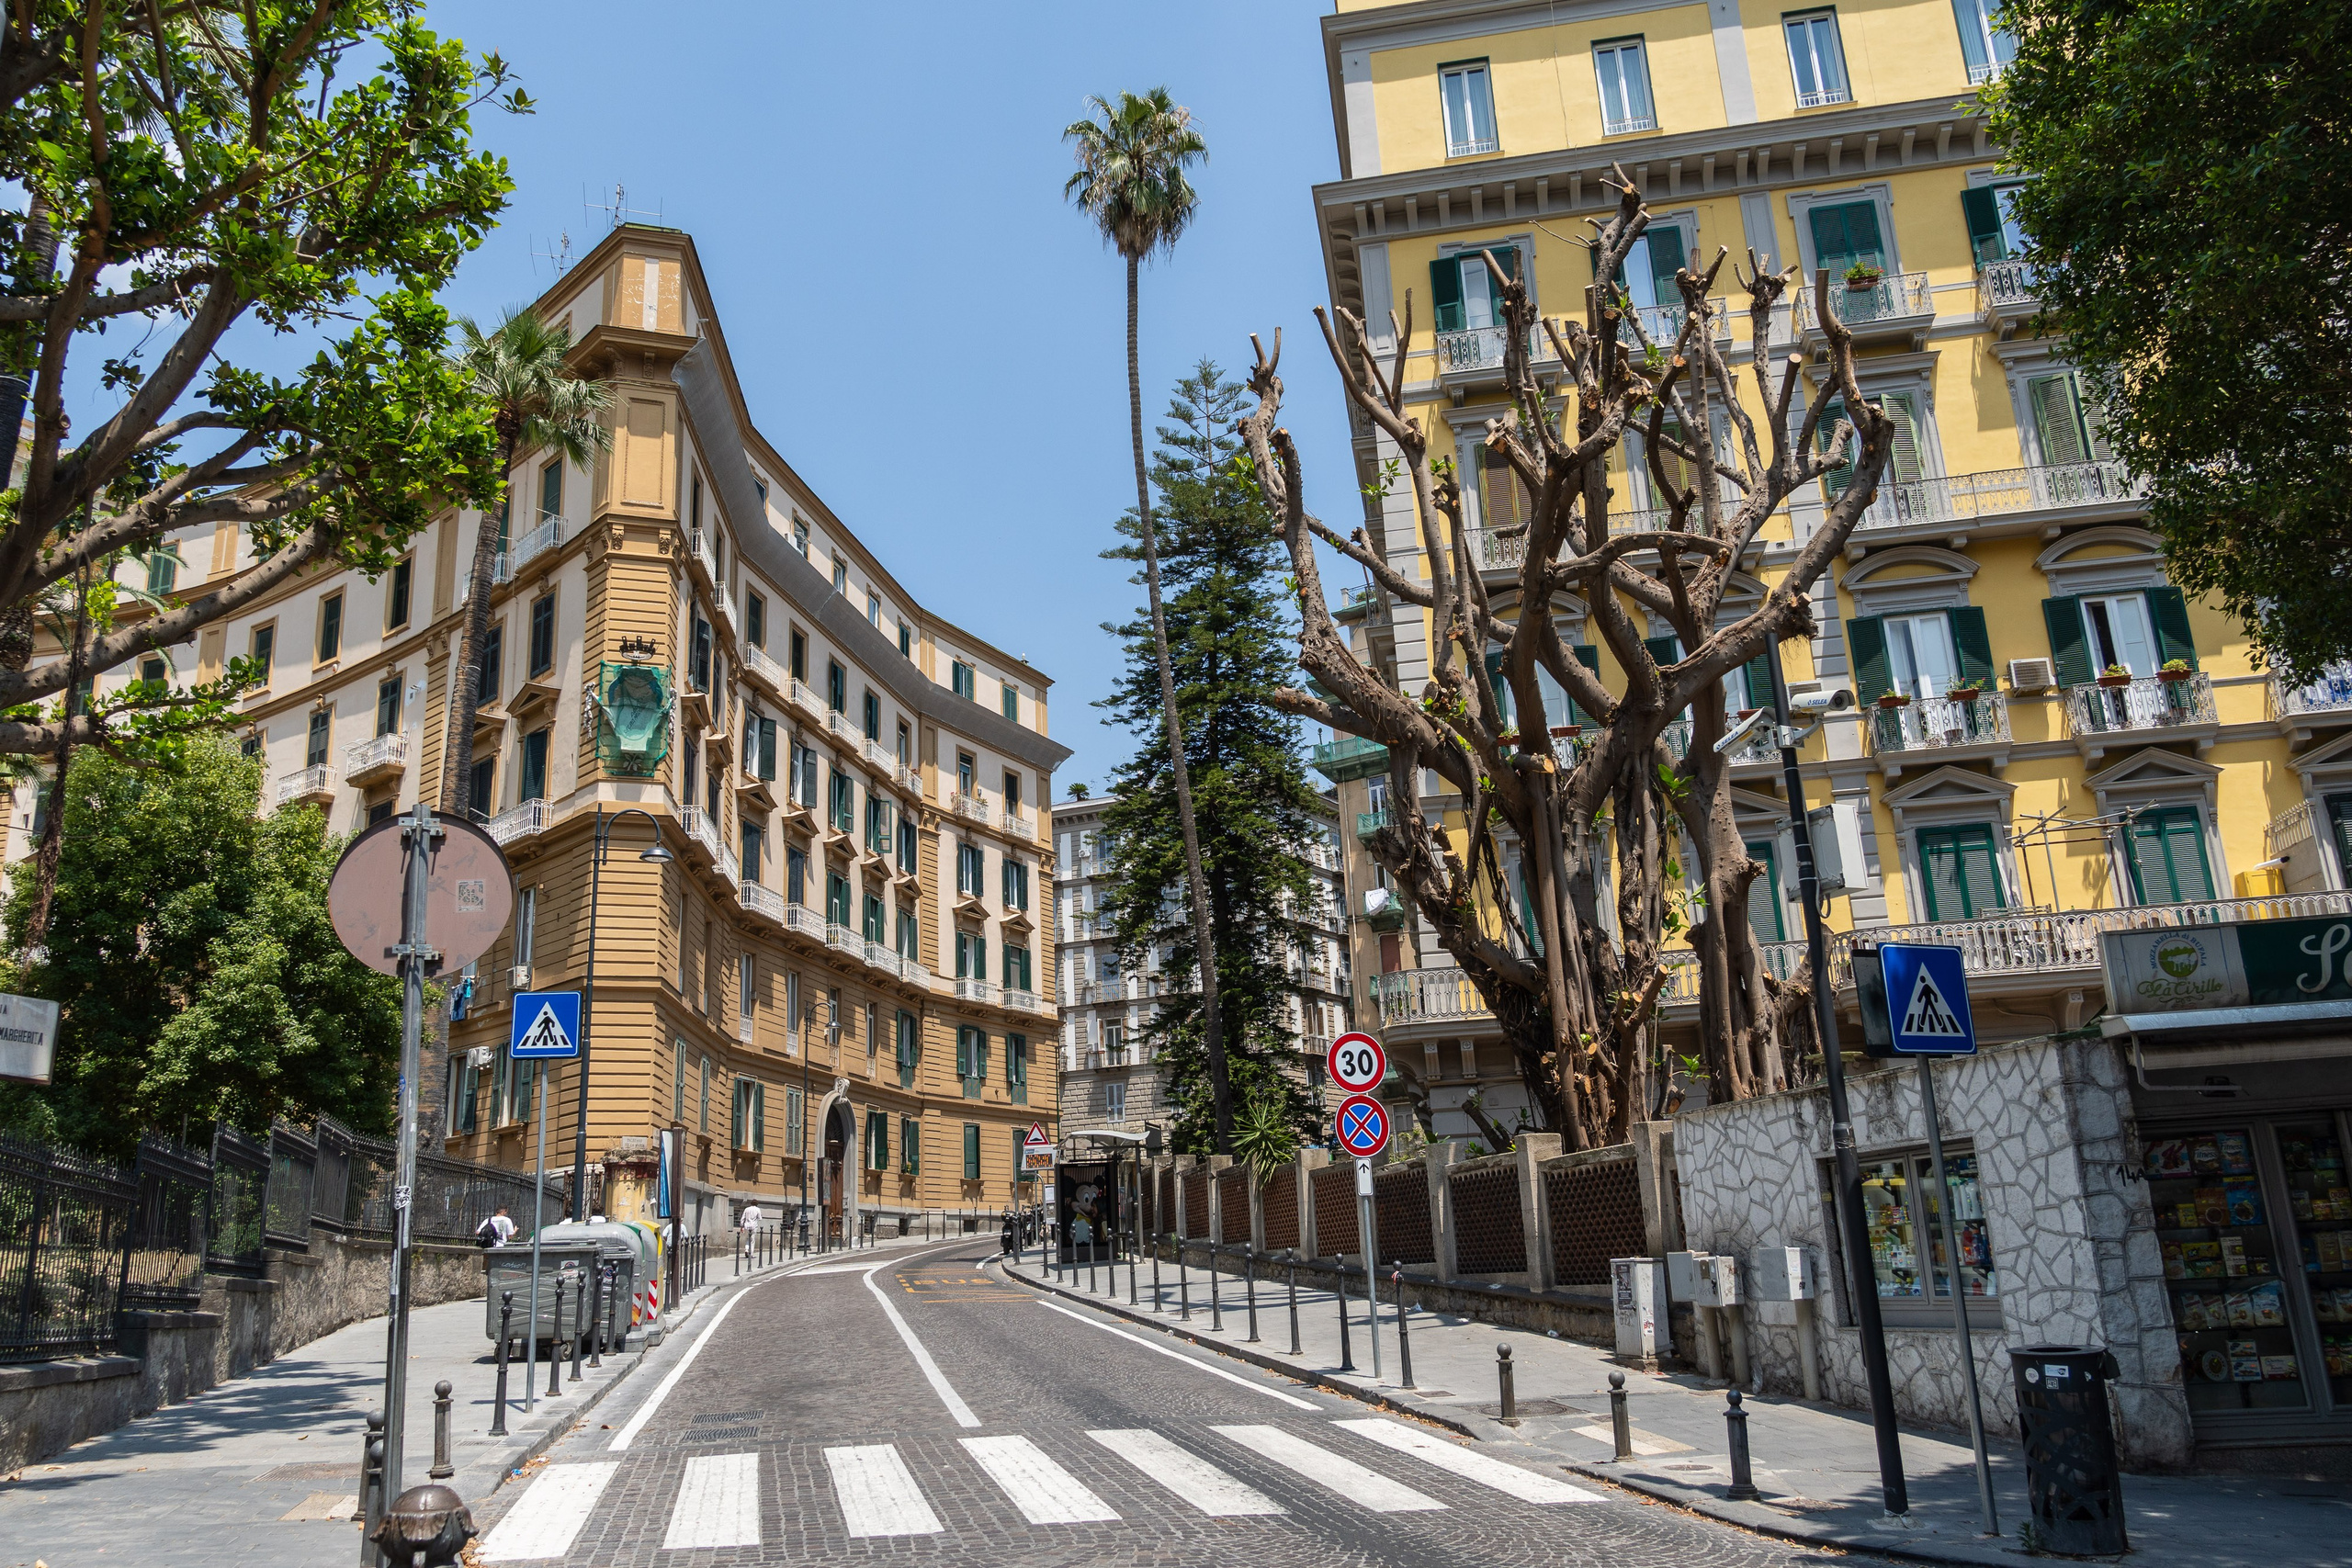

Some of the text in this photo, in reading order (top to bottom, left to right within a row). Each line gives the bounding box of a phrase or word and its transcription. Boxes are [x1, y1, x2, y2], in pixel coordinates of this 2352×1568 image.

[1721, 731, 1739, 747] SELEA
[2150, 931, 2180, 969] MOZZARELLA
[2190, 937, 2207, 967] BUFALA
[2296, 923, 2352, 994] S
[2173, 977, 2224, 996] Cirillo
[1341, 1049, 1374, 1077] 30
